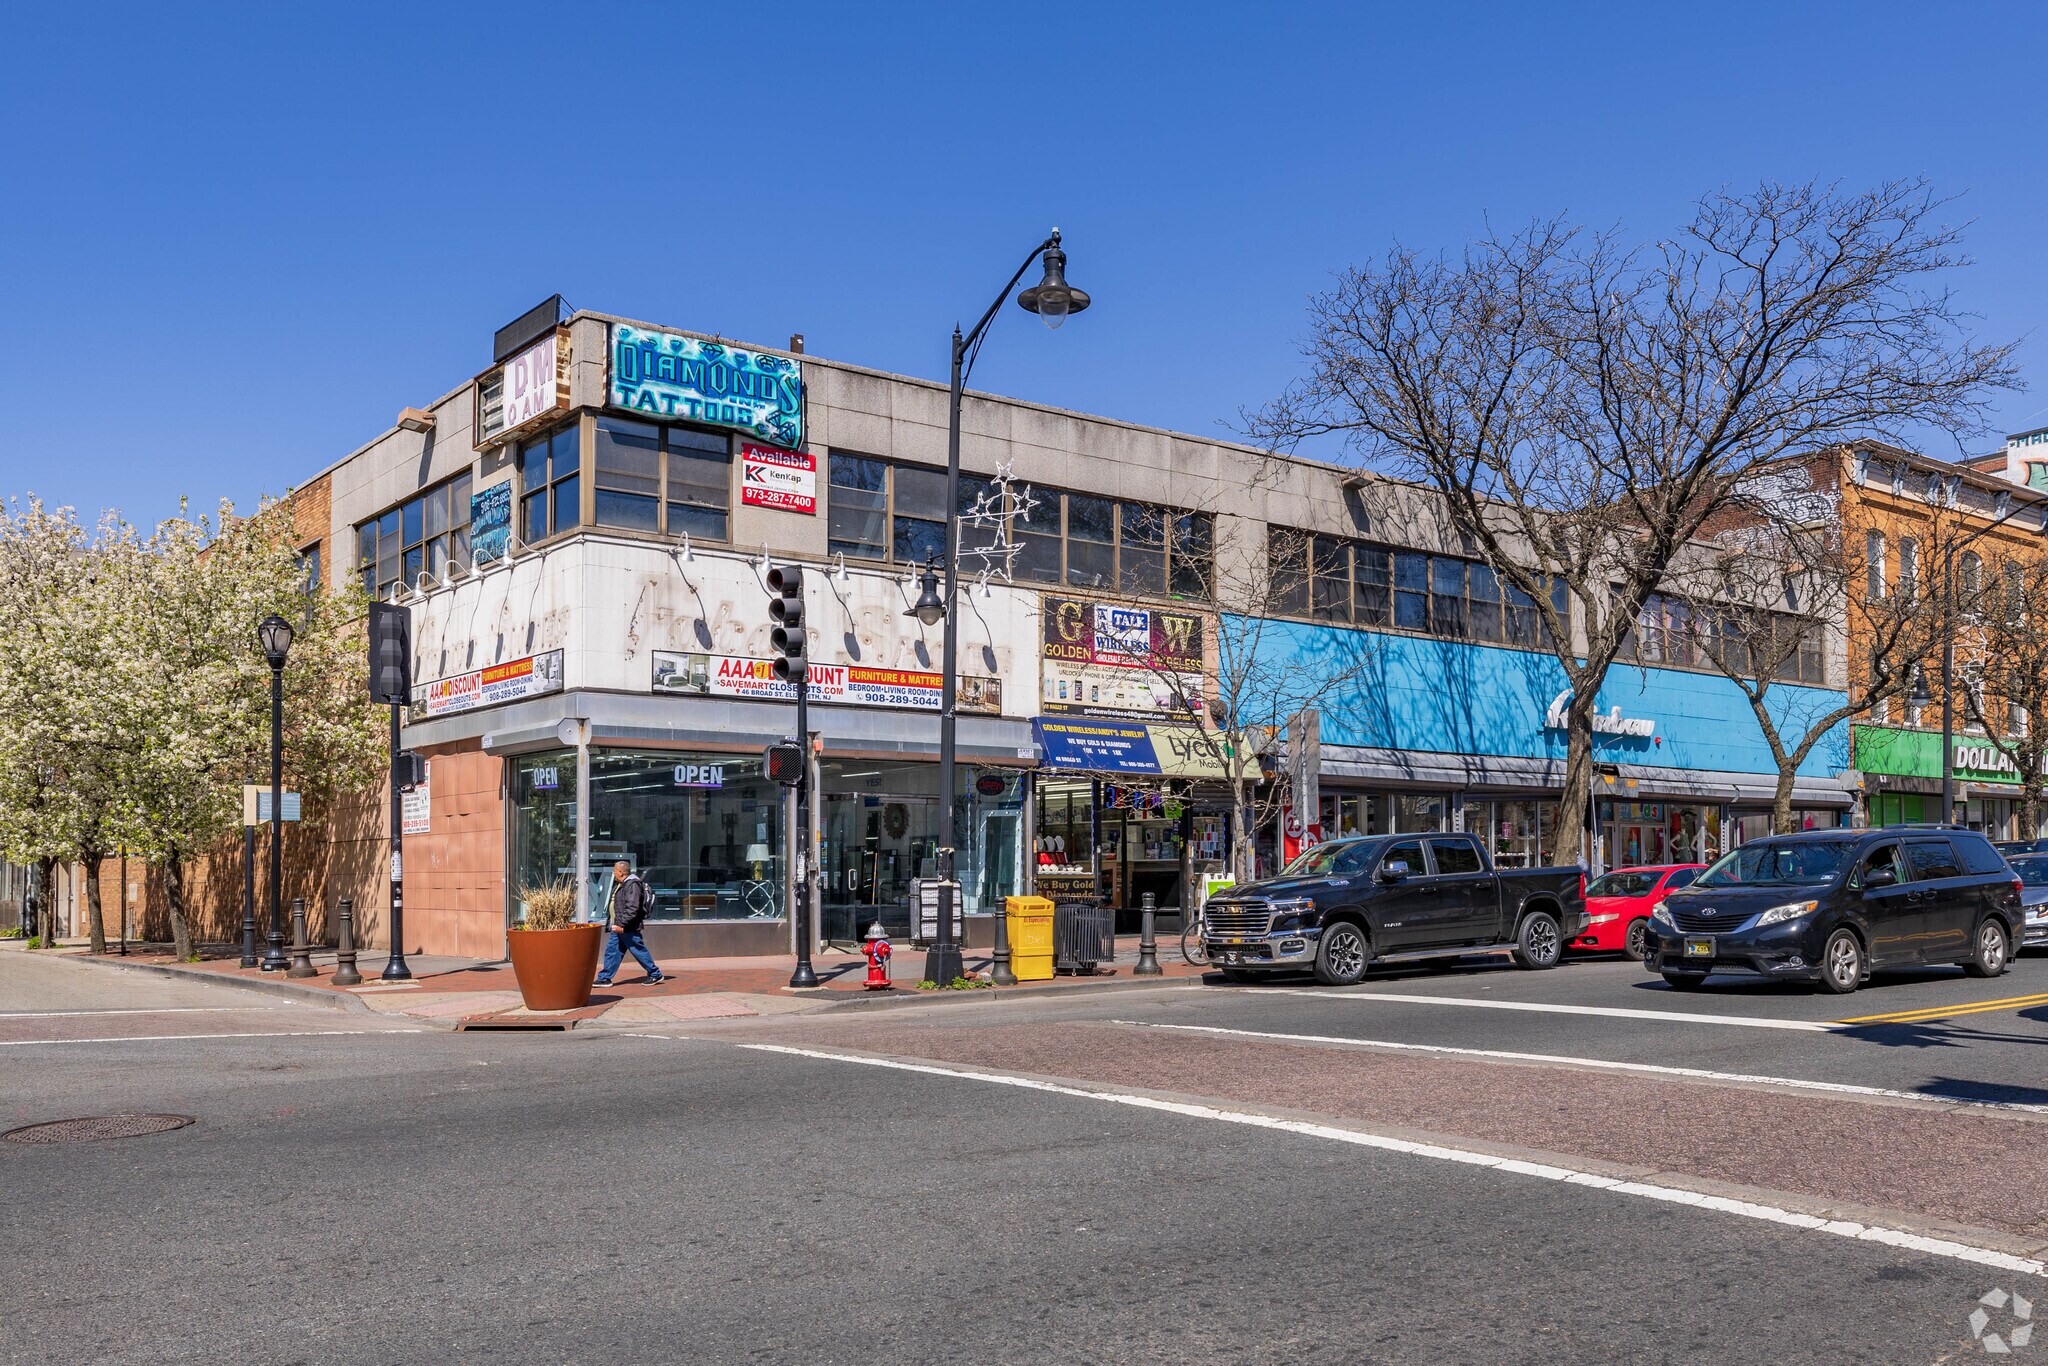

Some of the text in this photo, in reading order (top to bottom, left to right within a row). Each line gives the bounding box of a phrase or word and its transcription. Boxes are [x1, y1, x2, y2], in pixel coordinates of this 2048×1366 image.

[618, 341, 801, 415] DIAMONDS
[749, 448, 811, 469] Available
[770, 470, 802, 484] KenKap
[746, 488, 811, 507] 973-287-7400
[1056, 601, 1084, 641] G
[1113, 614, 1146, 628] TALK
[1161, 616, 1194, 652] W
[1044, 643, 1092, 659] GOLDEN
[718, 659, 844, 685] AAA #1 DUNT
[849, 670, 943, 687] FURNITURE & MATTRE
[448, 673, 480, 696] DISCOUNT
[720, 679, 844, 695] SAVEMARTCLOSEUTS.COM
[751, 689, 773, 697] BROAD
[785, 692, 822, 700] ELIZETH,
[865, 693, 939, 706] 908-289-5044
[1042, 723, 1145, 739] GOLDEN WIRELESS/ANDY'S JEWELRY
[1105, 741, 1131, 749] DIAMONDS
[533, 767, 558, 786] OPEN
[674, 764, 723, 783] OPEN
[866, 778, 882, 787] YES!
[978, 780, 1004, 791] OPEN
[1052, 880, 1070, 891] Buy
[1072, 880, 1094, 889] Gold
